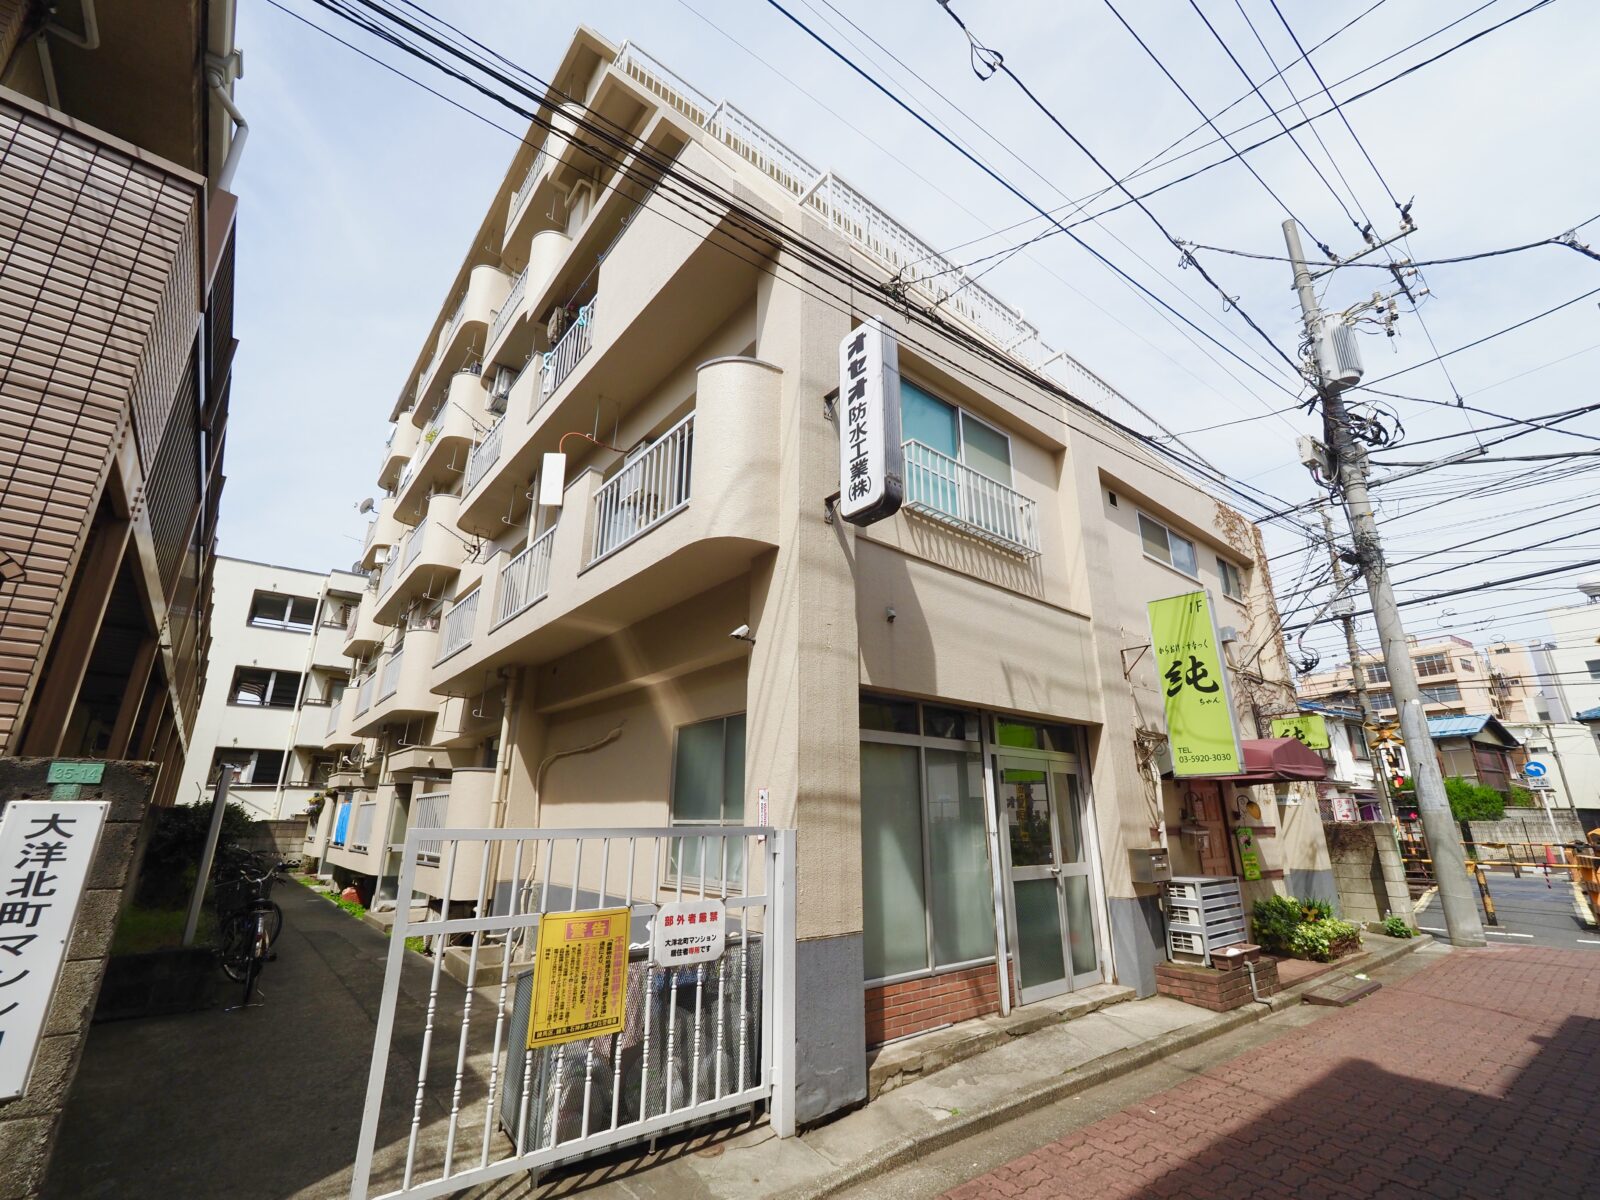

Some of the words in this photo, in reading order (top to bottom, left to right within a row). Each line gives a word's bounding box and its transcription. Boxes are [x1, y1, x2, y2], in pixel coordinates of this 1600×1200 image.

[1164, 655, 1220, 698] 純
[1199, 697, 1220, 705] ちゃん
[1179, 753, 1231, 763] 03-5920-3030
[55, 768, 98, 780] 35-14
[665, 911, 718, 927] 部外者厳禁
[570, 921, 607, 938] 警告
[665, 934, 717, 947] 大洋北町マンション
